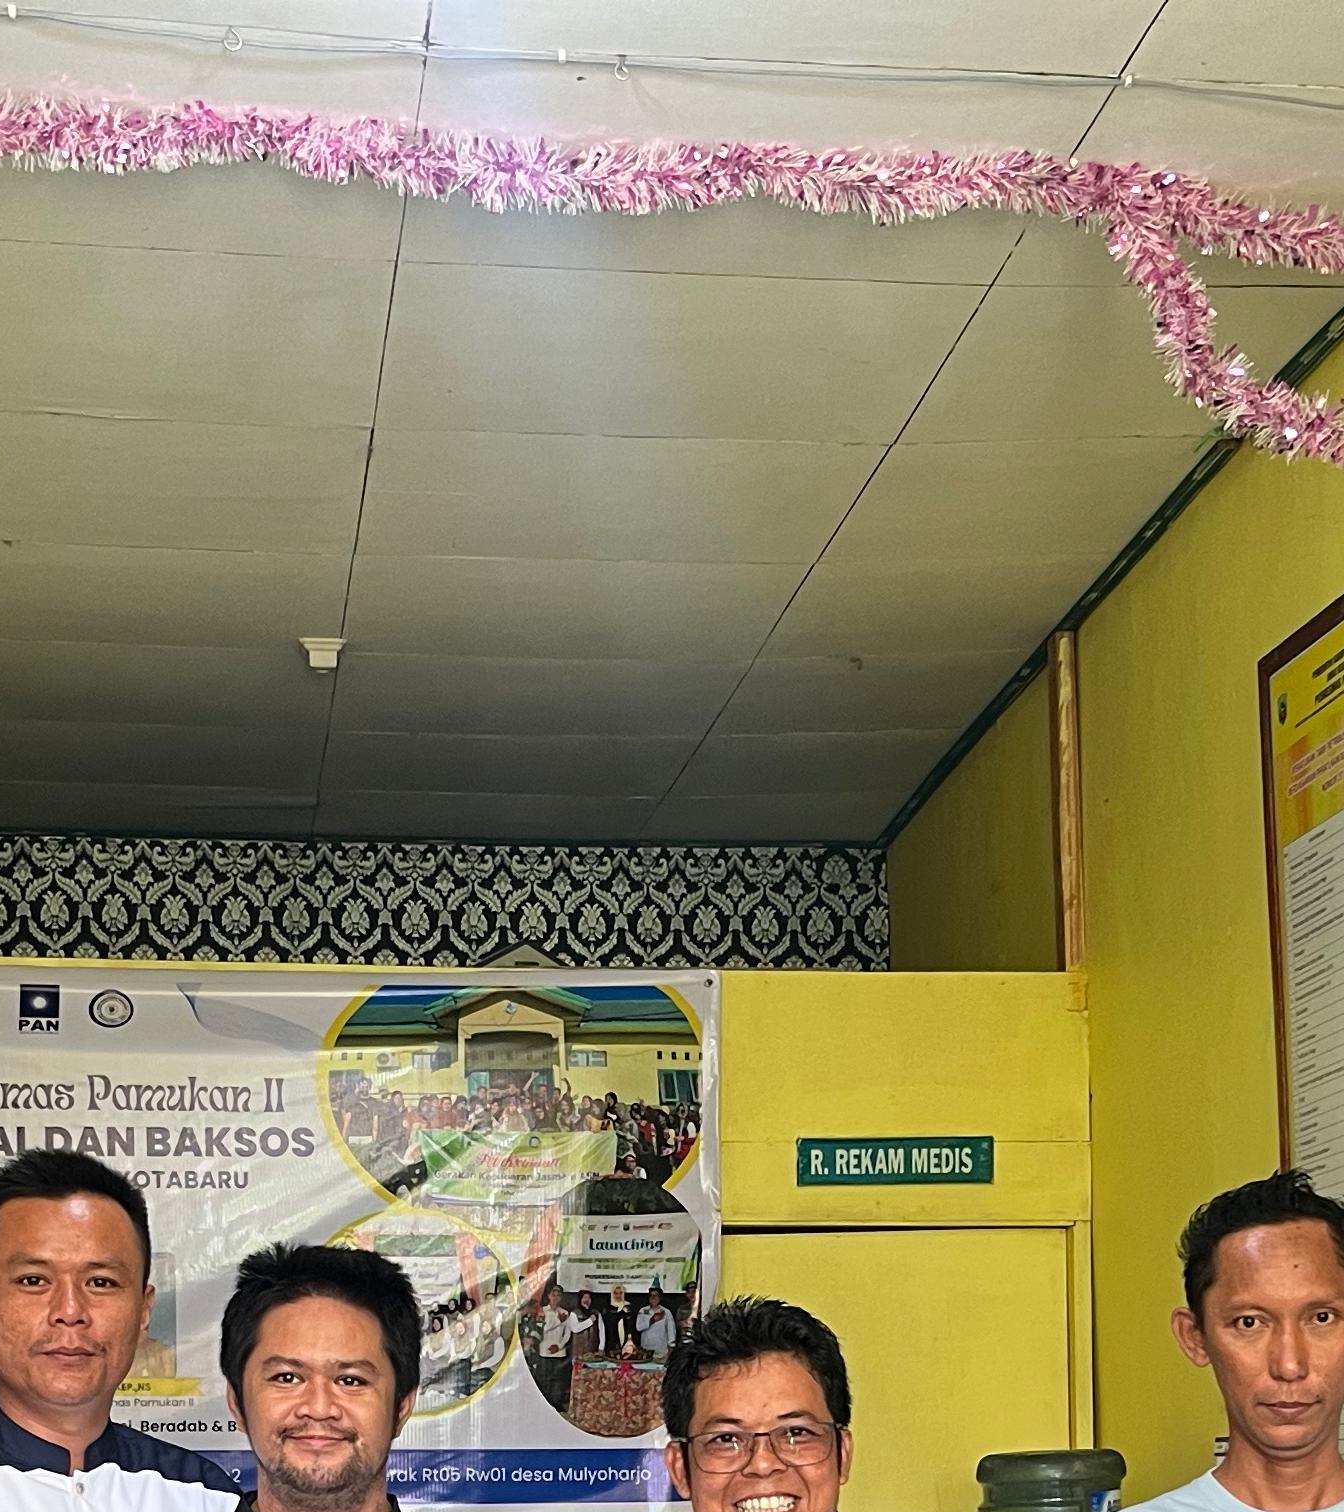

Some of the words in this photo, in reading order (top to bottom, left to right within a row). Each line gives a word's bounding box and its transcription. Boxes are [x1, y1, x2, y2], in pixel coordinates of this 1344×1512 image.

[18, 1019, 60, 1032] PAN
[87, 1074, 253, 1113] Pamukan
[263, 1077, 285, 1113] II
[44, 1126, 135, 1157] DAN
[145, 1126, 316, 1158] BAKSOS
[810, 1149, 829, 1176] R.
[835, 1148, 905, 1176] REKAM
[911, 1147, 973, 1174] MEDIS
[588, 1237, 665, 1253] Launching
[134, 1398, 186, 1408] Pamukan
[140, 1420, 208, 1433] Beradab
[211, 1421, 224, 1433] &
[422, 1467, 461, 1482] Rt05
[465, 1467, 507, 1482] Rw01
[511, 1466, 554, 1482] desa
[558, 1465, 652, 1486] Mulyoharjo
